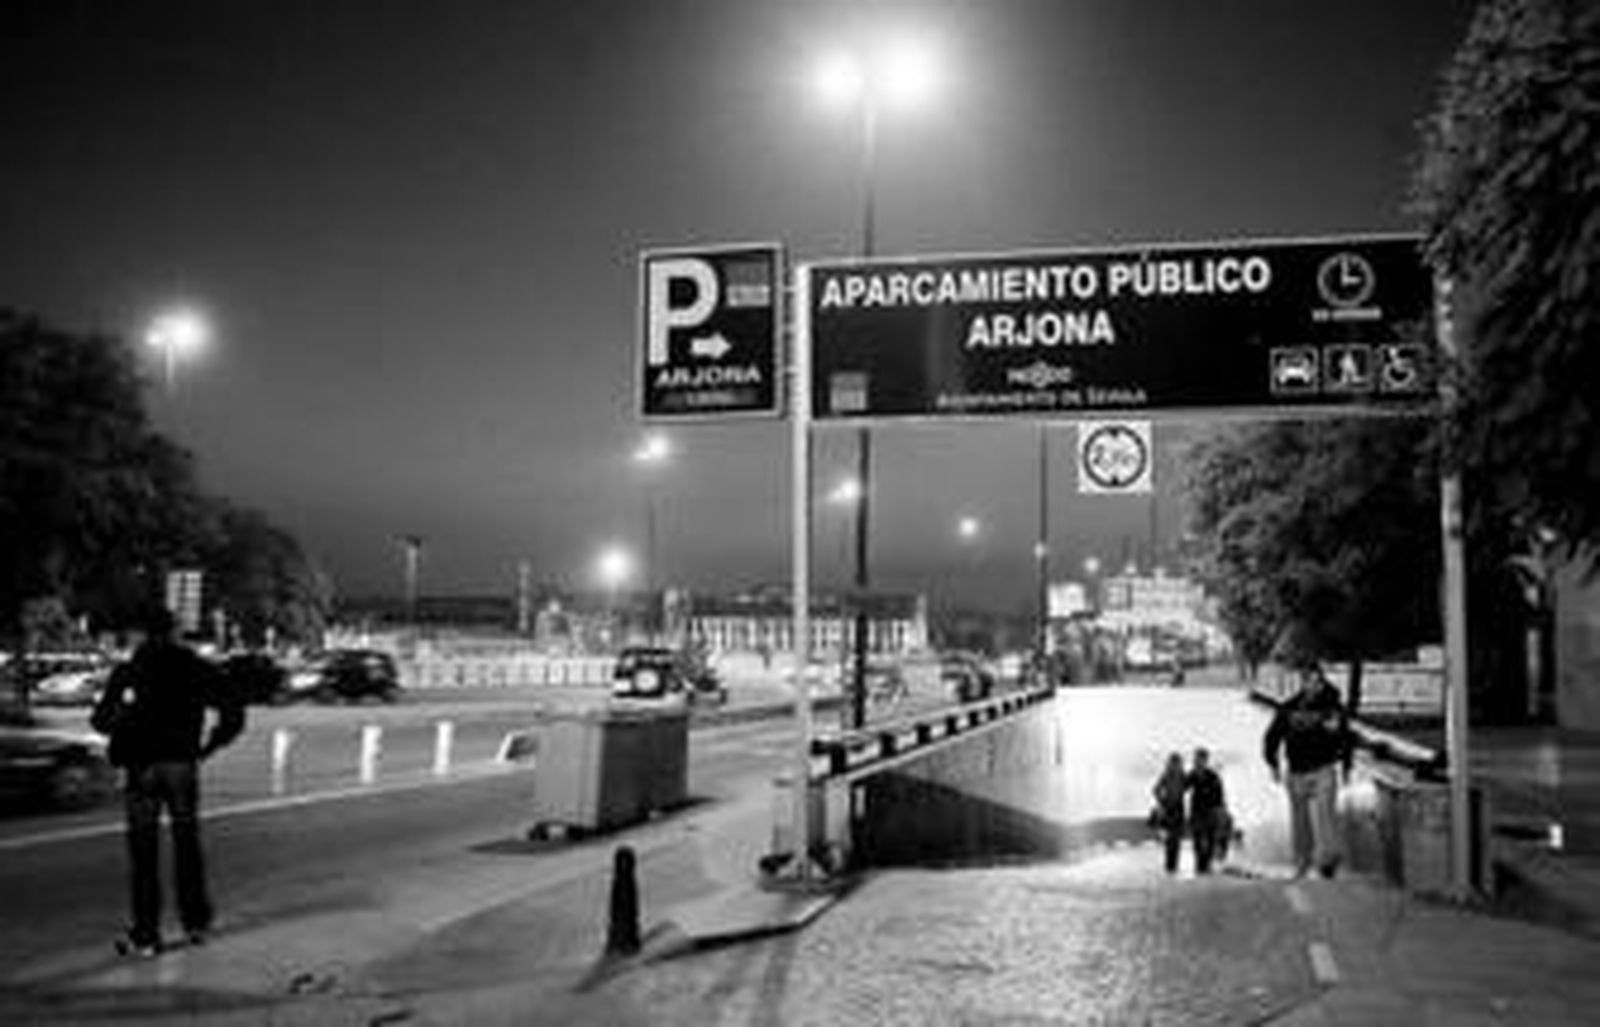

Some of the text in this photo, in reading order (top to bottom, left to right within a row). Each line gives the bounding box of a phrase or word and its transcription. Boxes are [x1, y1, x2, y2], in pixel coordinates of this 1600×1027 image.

[820, 265, 1097, 307] APARCAMIENTO
[1108, 254, 1271, 296] PÚBLICO
[648, 258, 718, 365] P
[966, 310, 1115, 348] ARJONA
[655, 365, 761, 388] ARJONA
